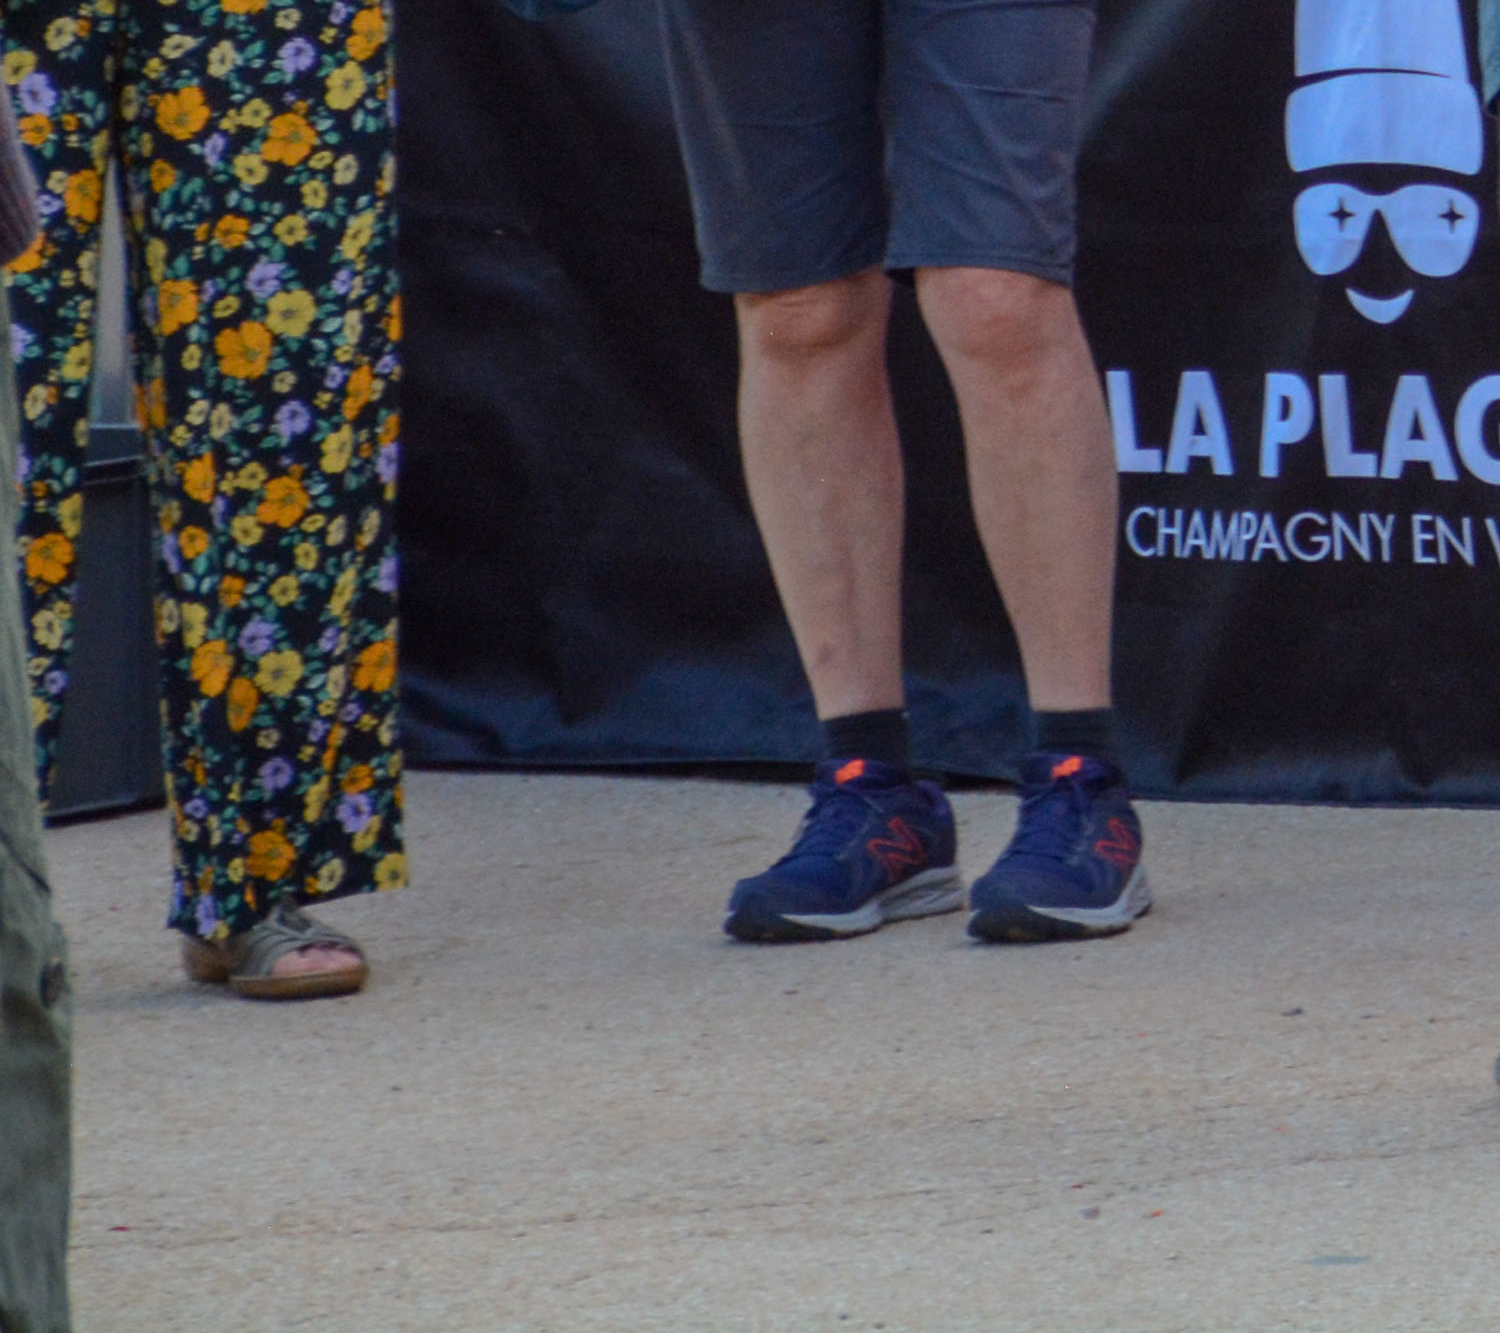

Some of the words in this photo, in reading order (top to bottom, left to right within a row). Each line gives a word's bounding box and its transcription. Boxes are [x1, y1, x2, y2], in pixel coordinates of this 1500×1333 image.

[1106, 370, 1234, 478] LA
[1126, 506, 1396, 564] CHAMPAGNY
[1412, 512, 1476, 566] EN
